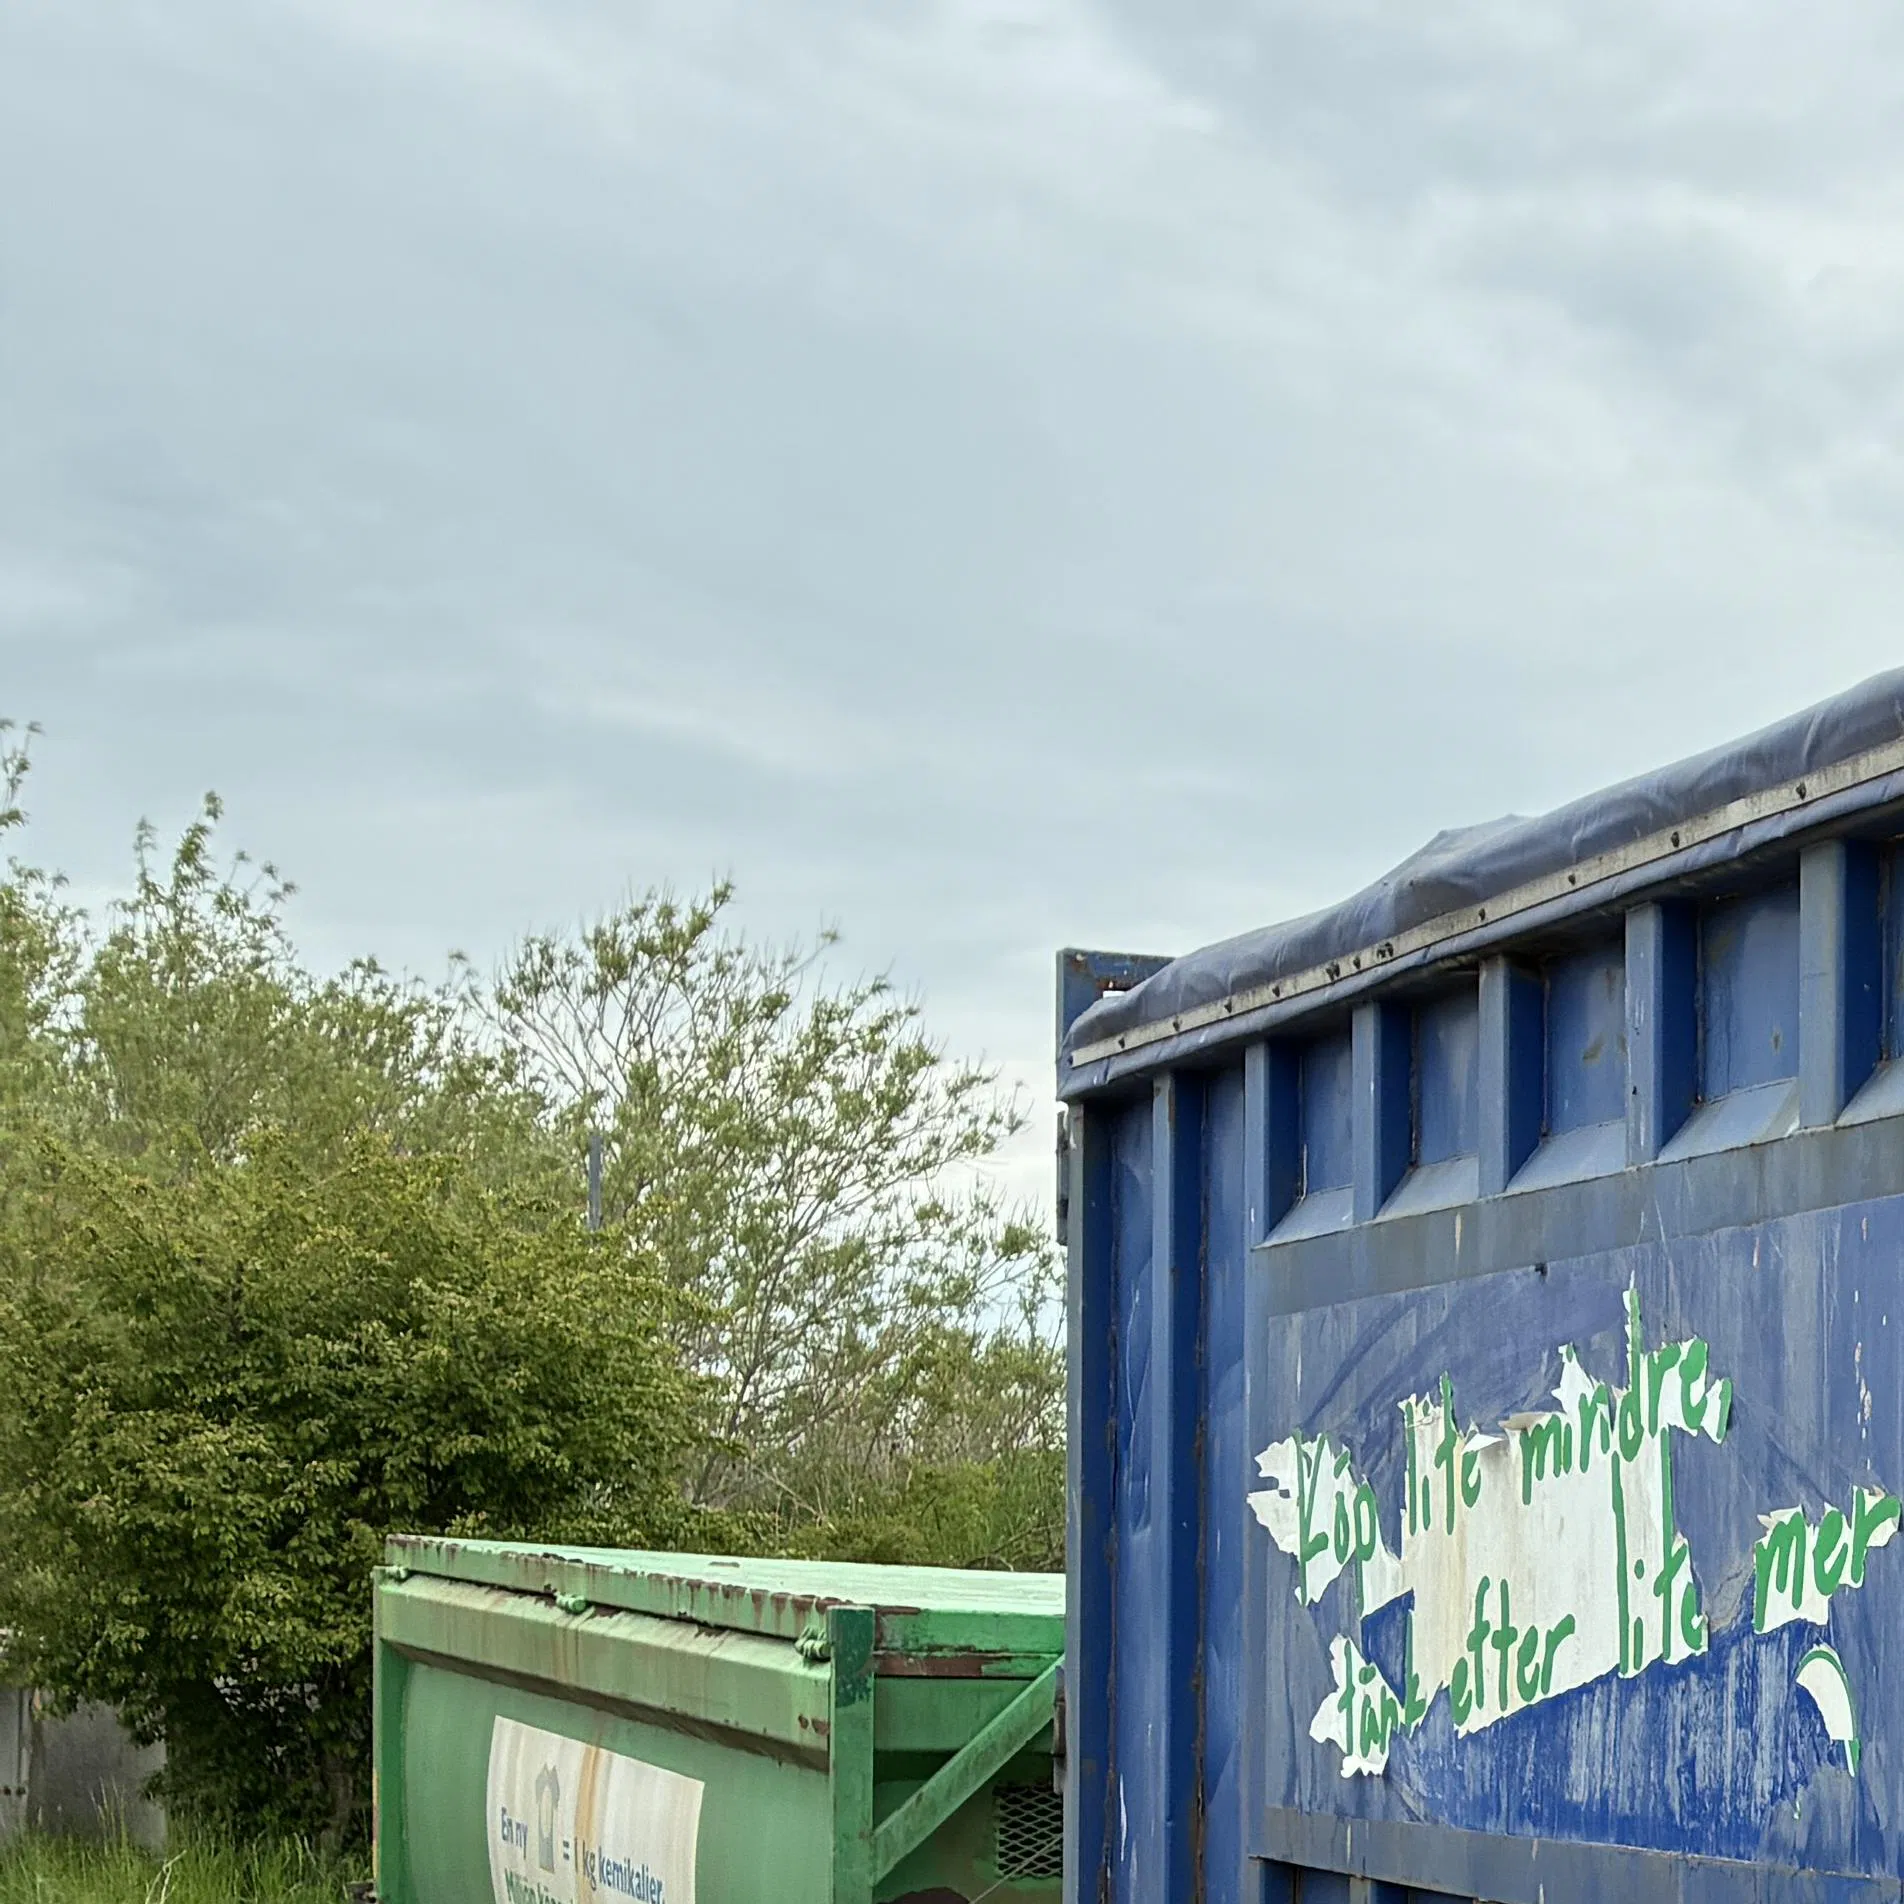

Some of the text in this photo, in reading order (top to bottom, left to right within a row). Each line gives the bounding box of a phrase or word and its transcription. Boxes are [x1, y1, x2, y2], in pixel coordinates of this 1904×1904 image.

[1404, 1371, 1482, 1537] lite
[1450, 1575, 1577, 1728] efter
[1611, 1427, 1704, 1675] lite
[1754, 1487, 1902, 1633] mer
[582, 1839, 598, 1892] kg
